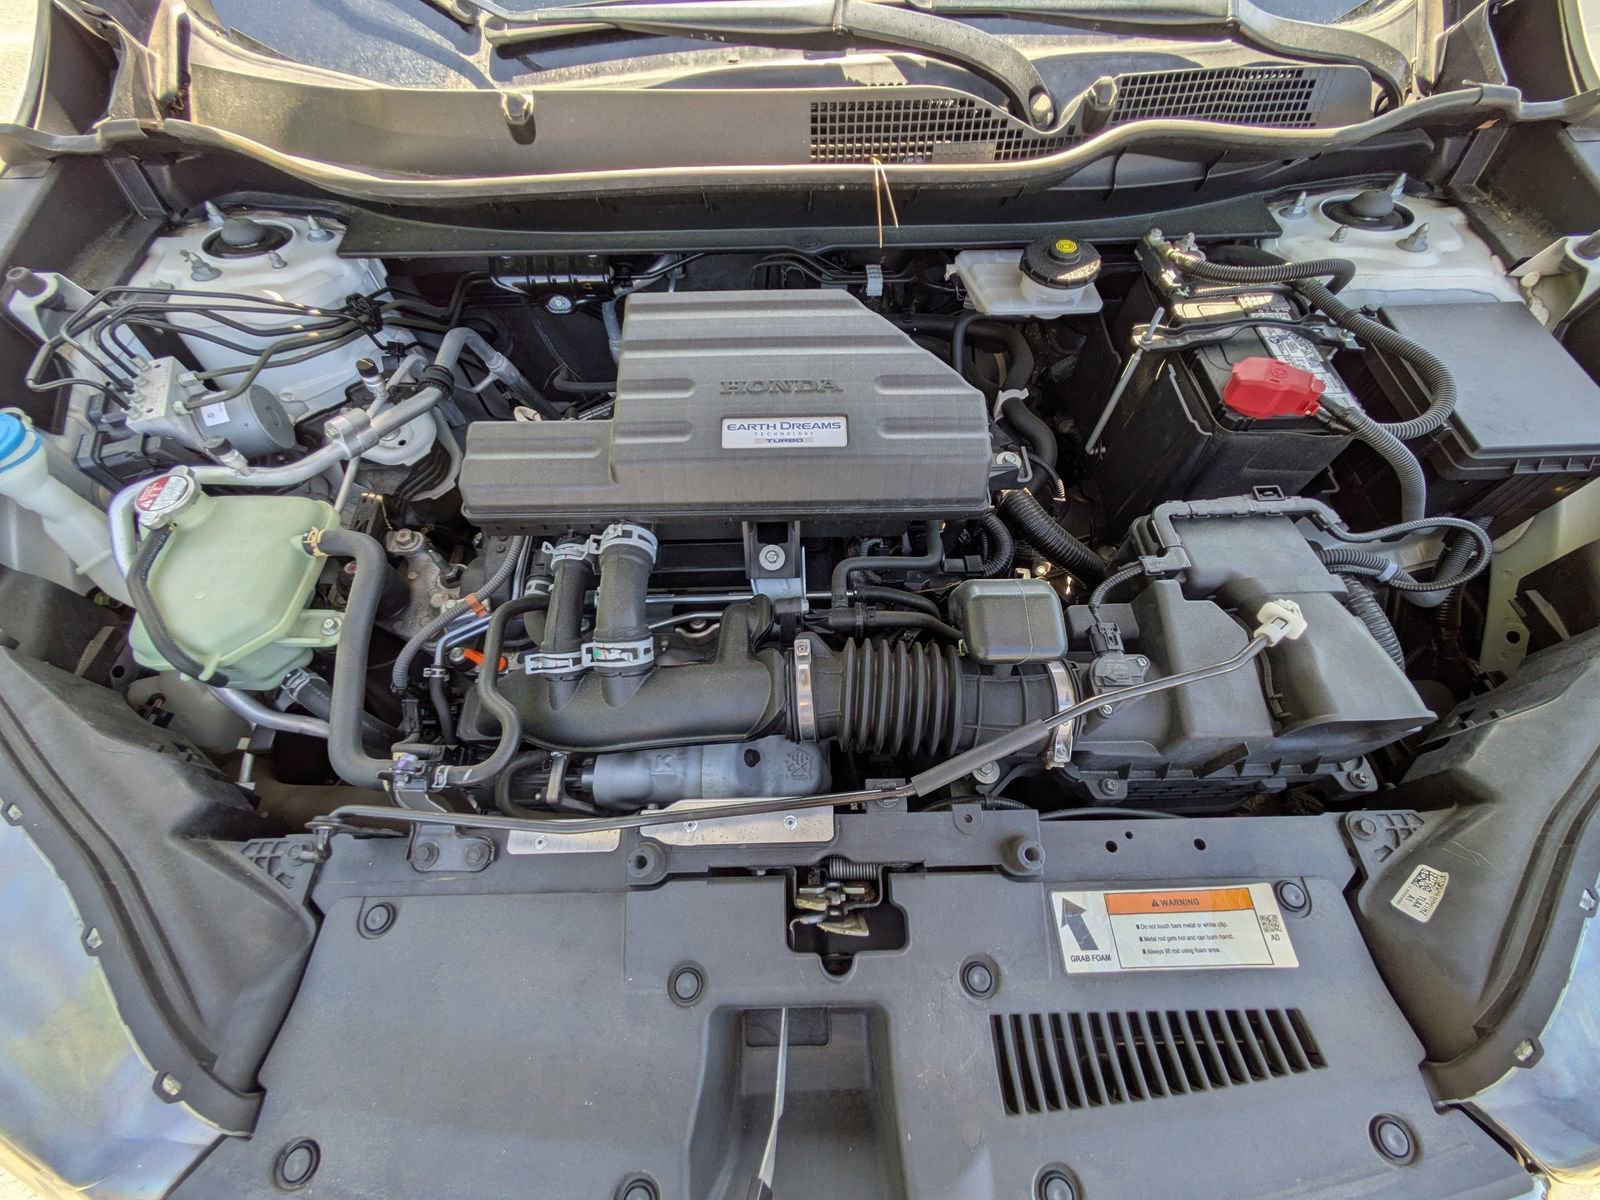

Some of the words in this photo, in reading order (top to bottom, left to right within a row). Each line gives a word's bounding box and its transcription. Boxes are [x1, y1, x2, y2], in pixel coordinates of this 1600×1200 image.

[720, 380, 843, 395] HONDA
[726, 423, 777, 431] EARTH
[780, 421, 842, 430] DREAMS
[1160, 898, 1200, 907] WARNING
[1070, 954, 1091, 963] GRAB
[1092, 953, 1112, 962] FOAM
